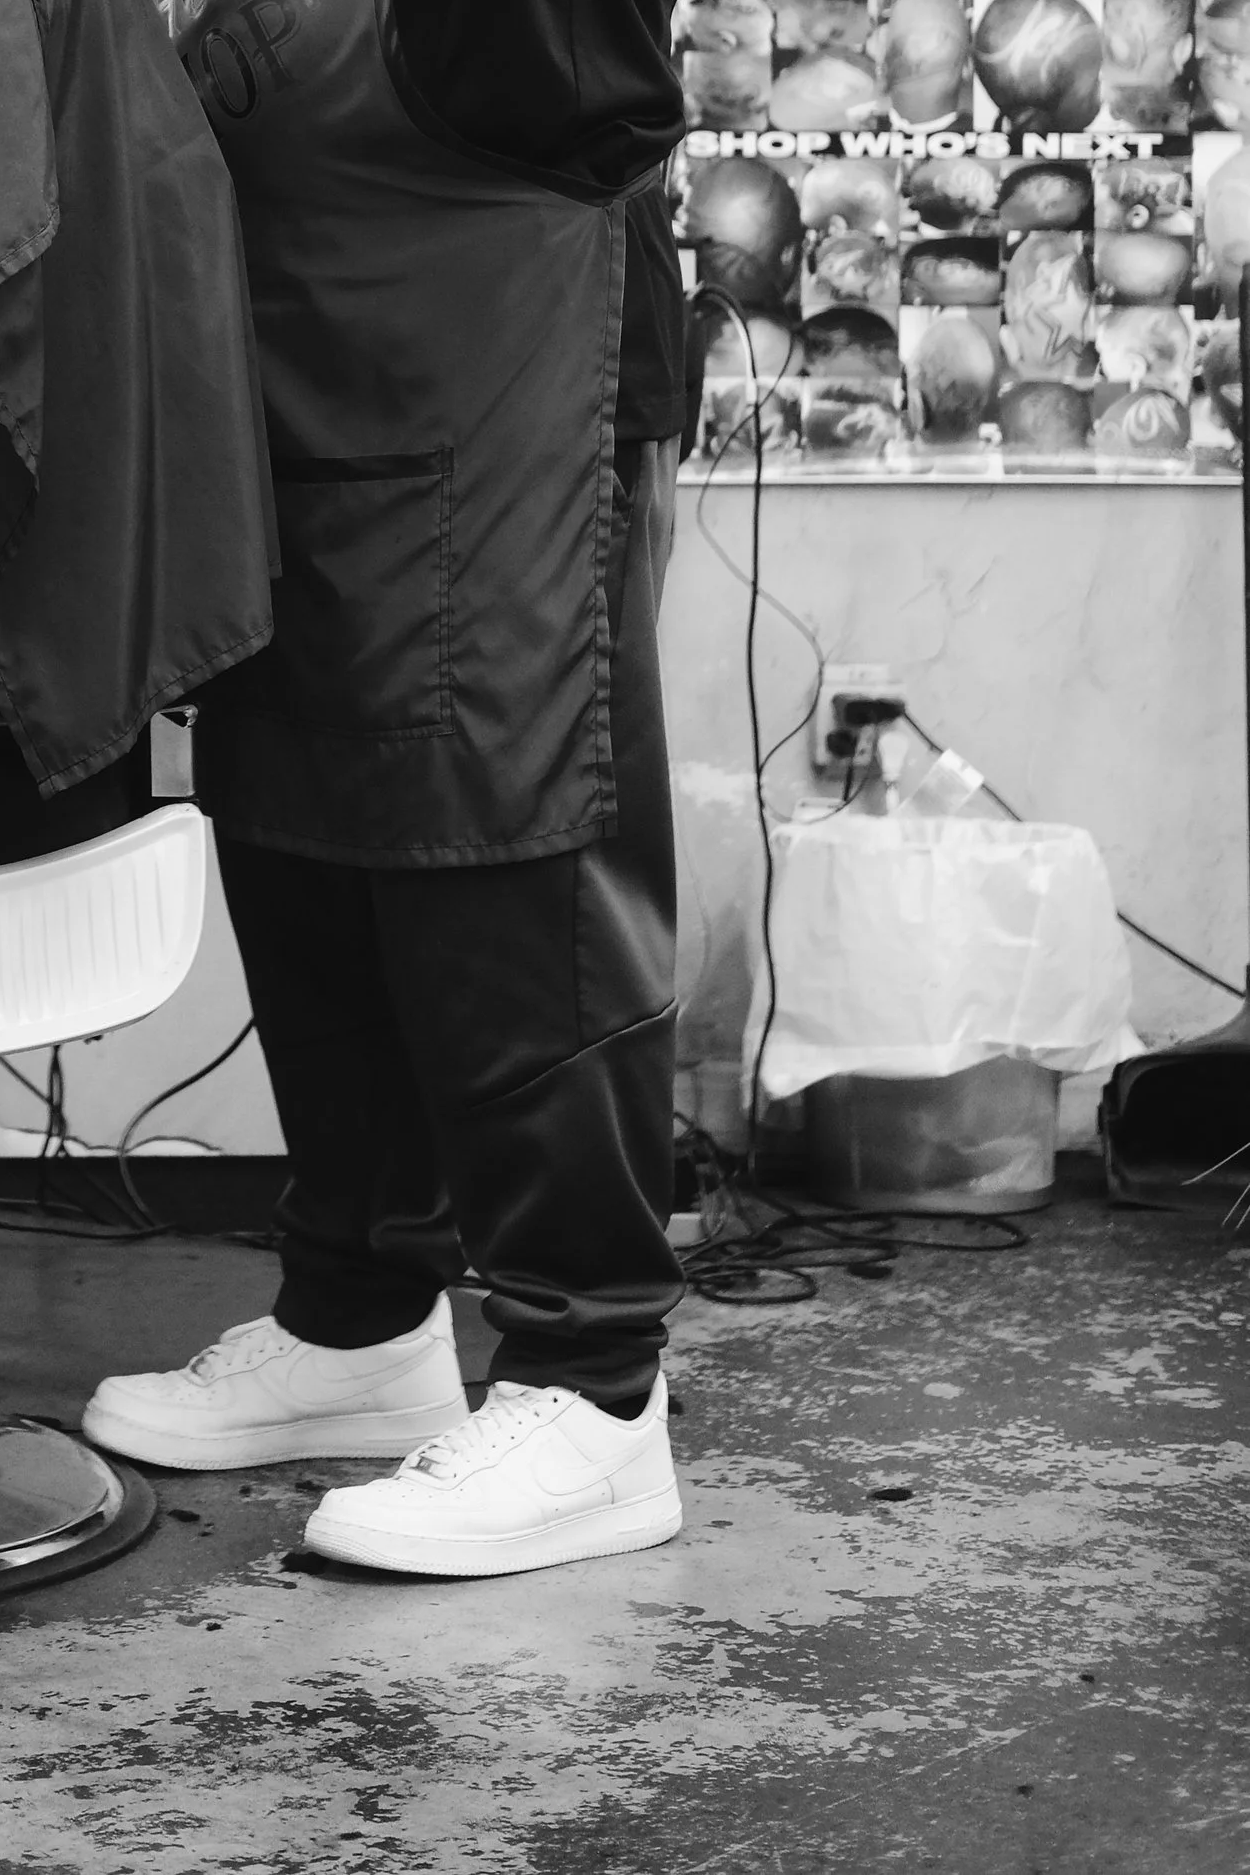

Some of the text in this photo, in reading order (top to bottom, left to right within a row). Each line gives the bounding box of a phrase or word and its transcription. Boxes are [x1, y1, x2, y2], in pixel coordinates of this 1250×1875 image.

[686, 130, 1164, 160] SHOP WHO'S NEXT
